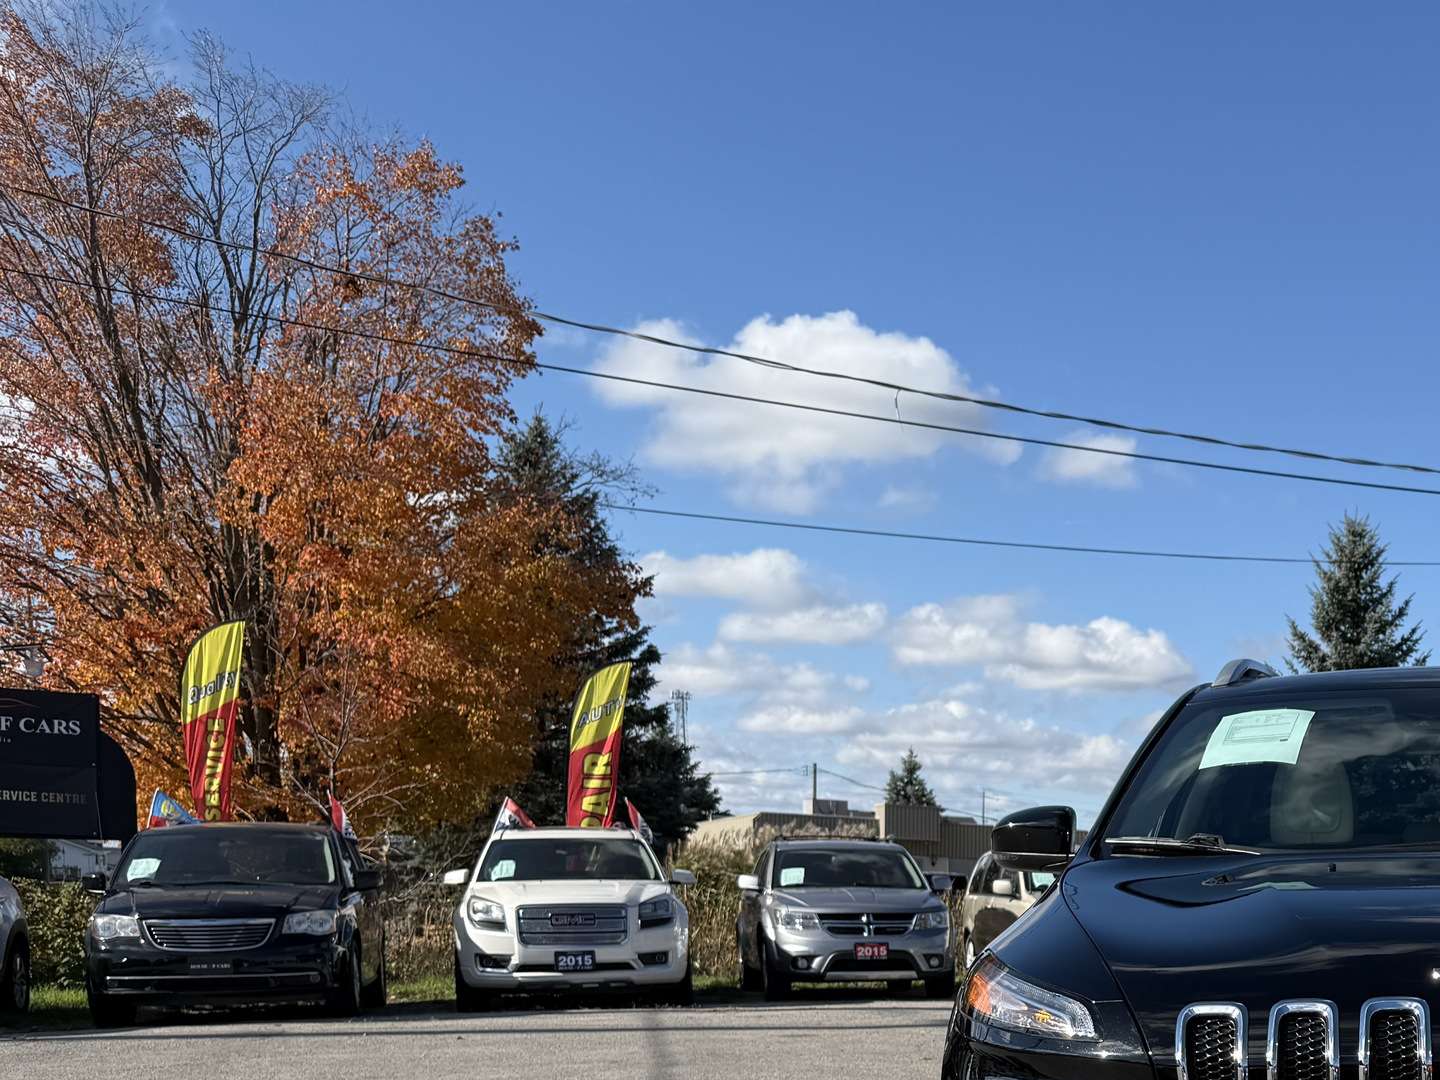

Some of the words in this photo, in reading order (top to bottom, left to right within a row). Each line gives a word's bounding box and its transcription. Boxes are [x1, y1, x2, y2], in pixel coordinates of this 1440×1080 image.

[18, 716, 81, 736] CARS
[857, 945, 888, 957] 2015
[558, 954, 593, 966] 2015
